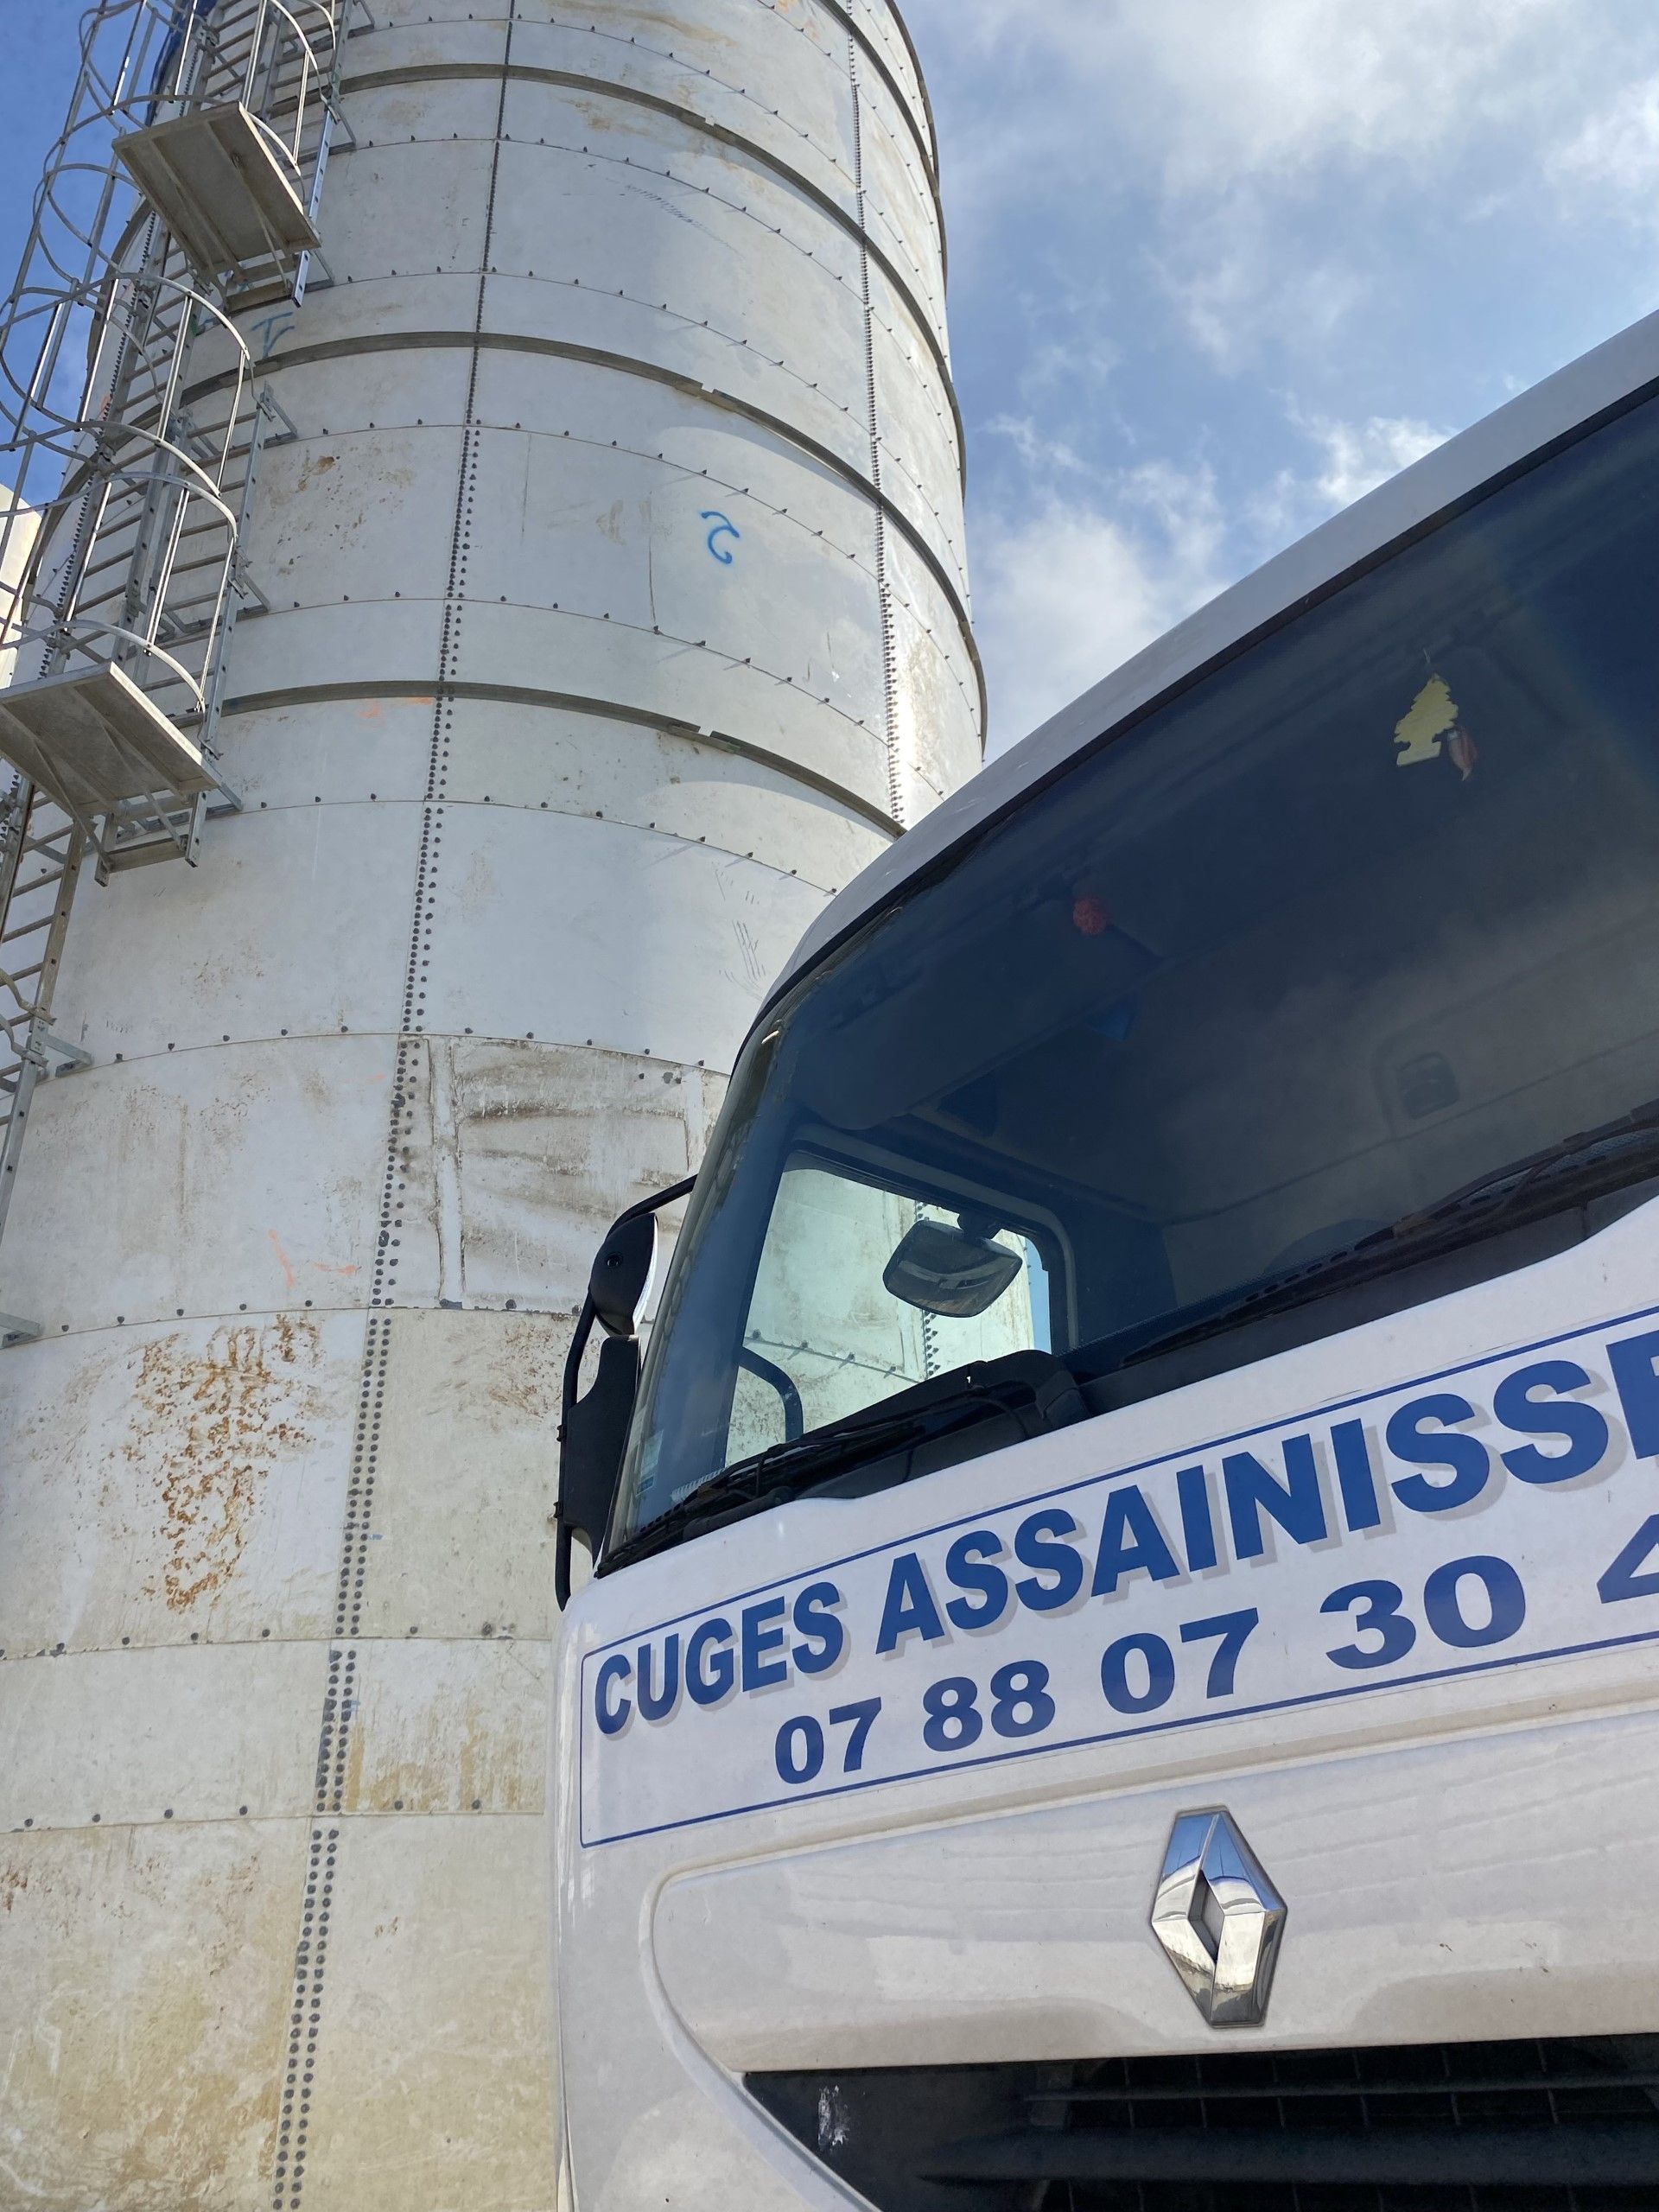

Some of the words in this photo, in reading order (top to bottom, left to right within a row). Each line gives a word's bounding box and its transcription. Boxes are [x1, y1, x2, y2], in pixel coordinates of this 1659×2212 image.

[594, 1581, 844, 1735] CUGES
[774, 1697, 882, 1784] 07
[922, 1659, 1056, 1752] 88
[1100, 1607, 1260, 1714] 07
[1319, 1554, 1527, 1669] 30
